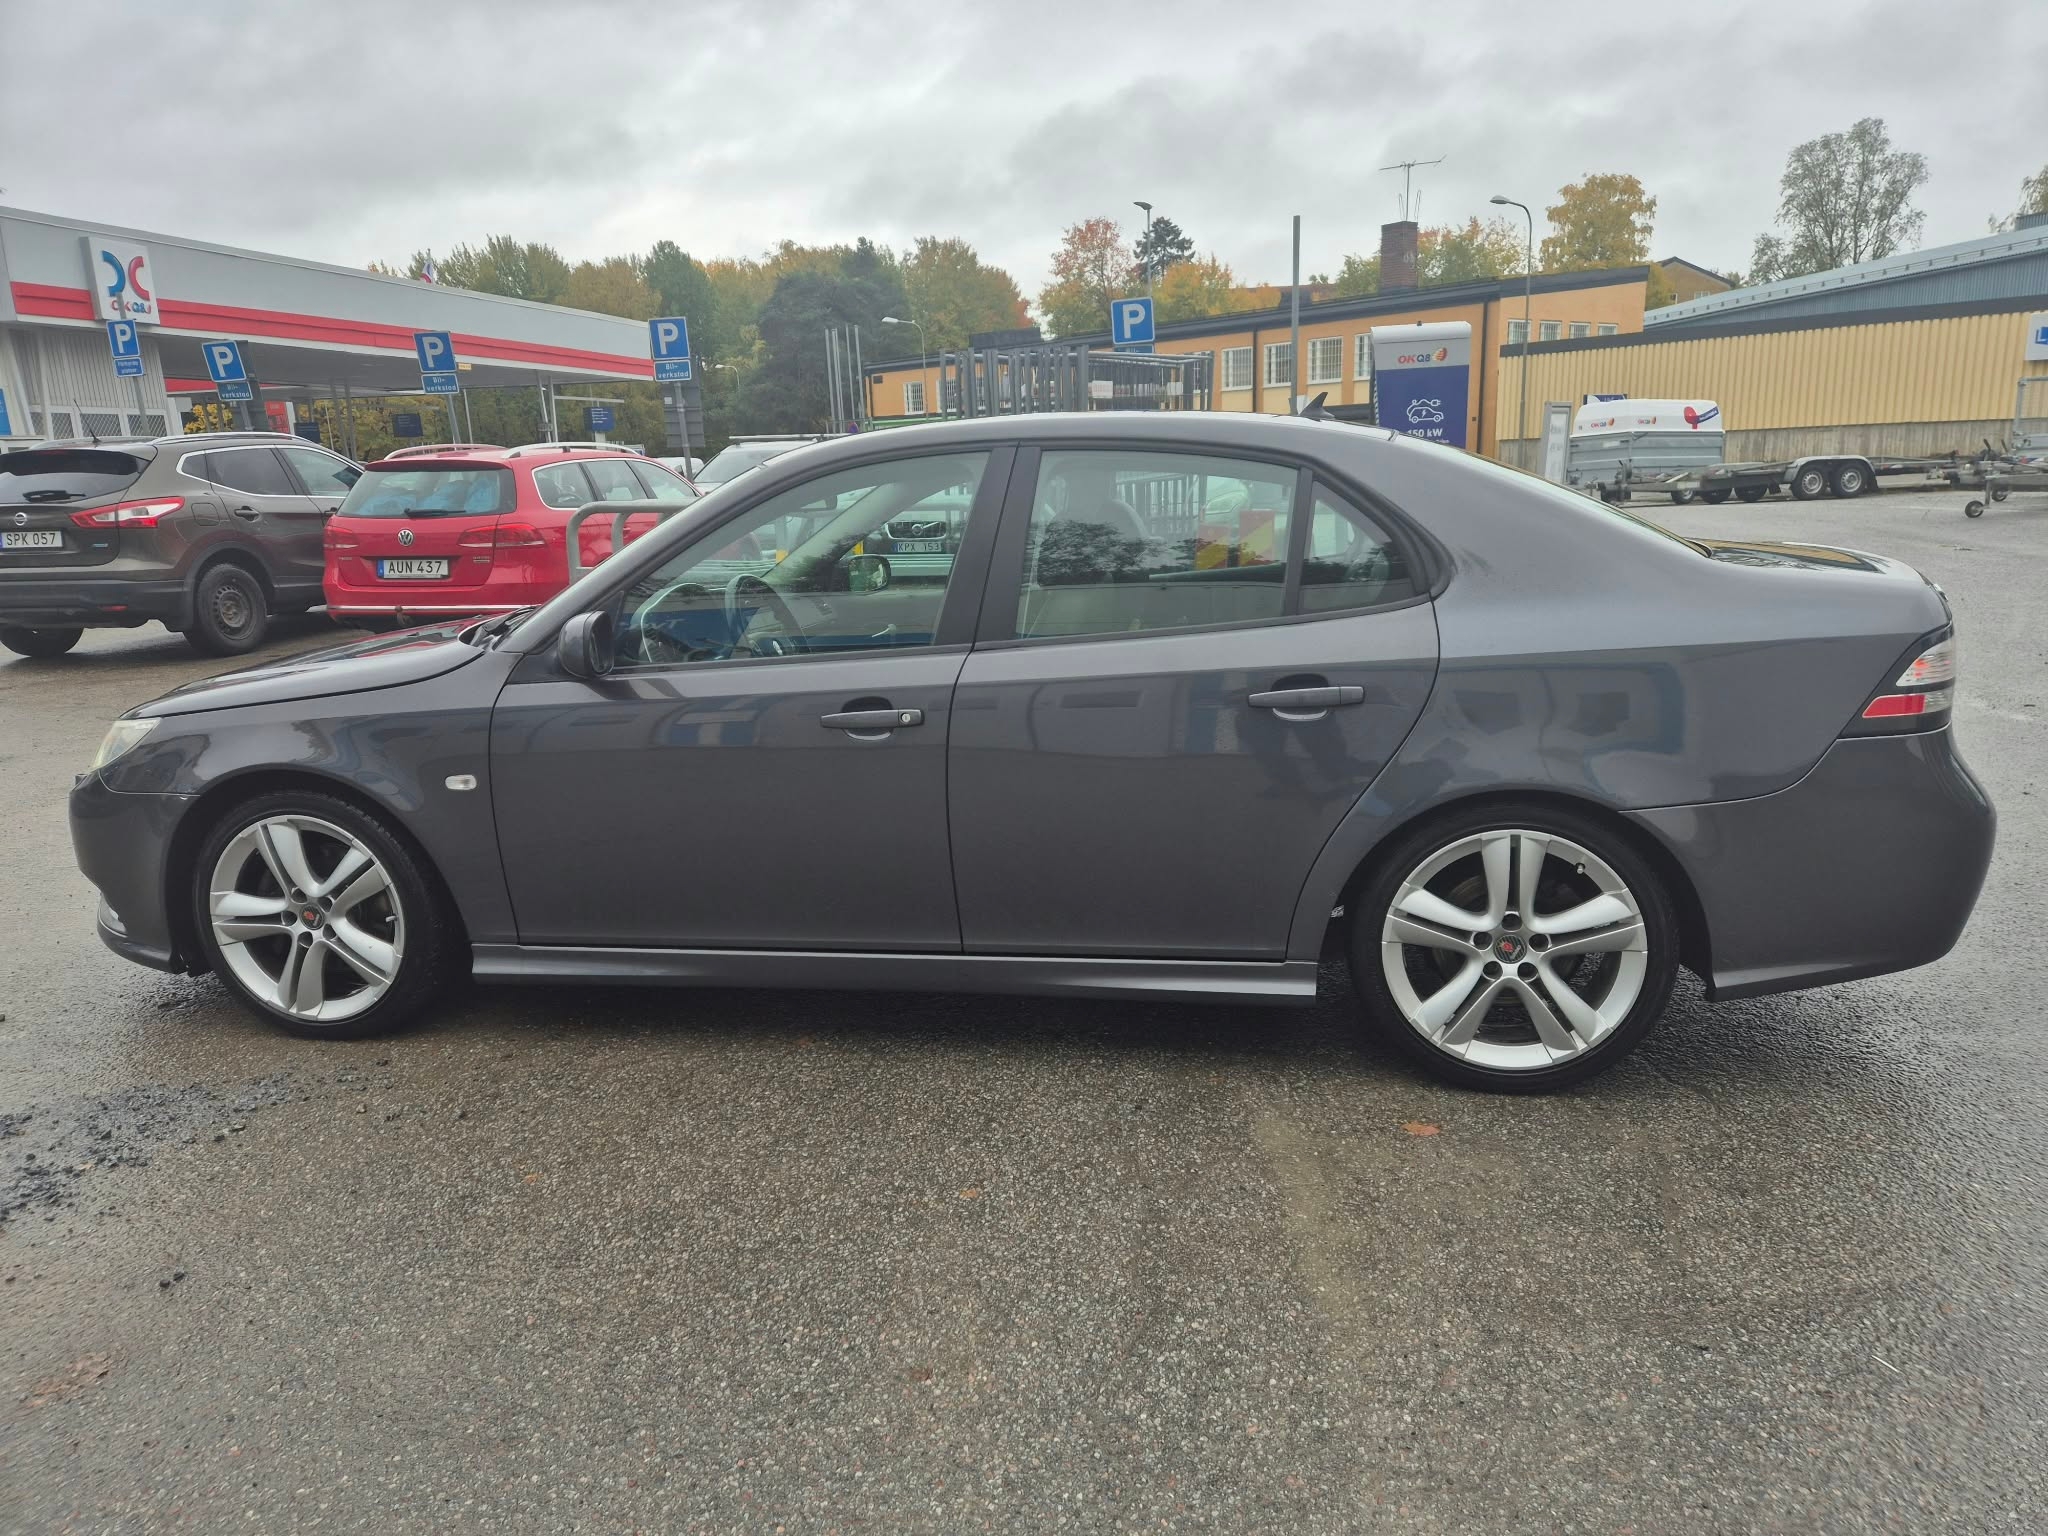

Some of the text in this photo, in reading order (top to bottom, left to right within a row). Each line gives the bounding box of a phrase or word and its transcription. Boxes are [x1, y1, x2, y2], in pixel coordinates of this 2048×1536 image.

[1122, 303, 1146, 339] P
[114, 323, 132, 354] P
[421, 336, 444, 368] P
[657, 322, 679, 355] P
[211, 346, 233, 378] P
[1426, 428, 1443, 437] kW
[6, 532, 56, 546] SPK 057
[898, 543, 916, 552] KPX
[388, 561, 442, 574] AUN 437
